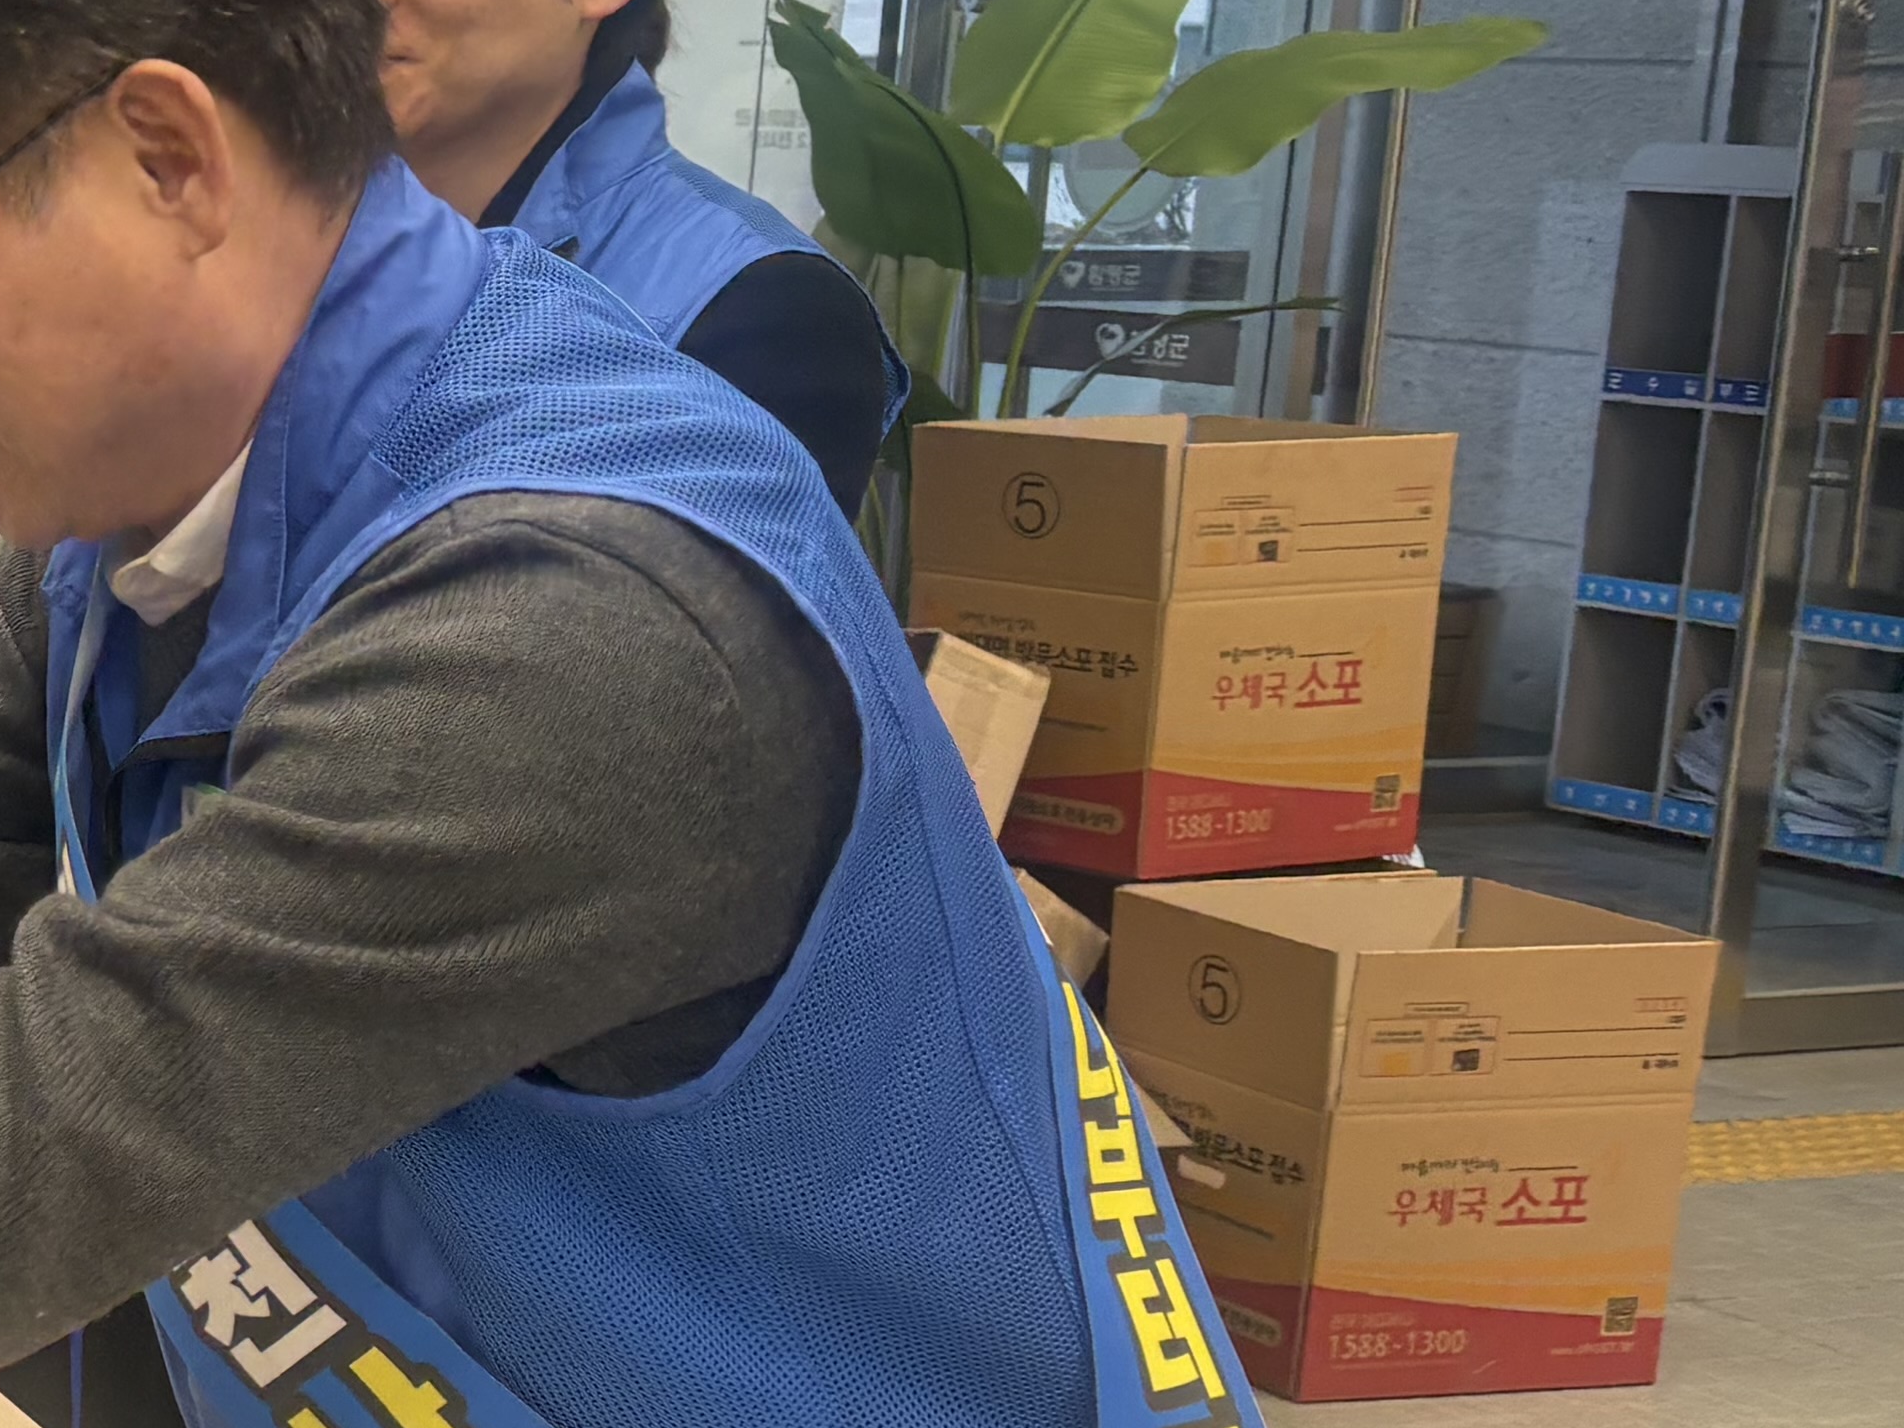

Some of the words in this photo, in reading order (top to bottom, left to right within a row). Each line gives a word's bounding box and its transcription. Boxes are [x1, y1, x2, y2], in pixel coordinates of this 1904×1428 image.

[1211, 675, 1288, 711] 우체국
[1294, 659, 1364, 709] 소포
[1166, 809, 1272, 841] 1588-1300
[1061, 981, 1224, 1401] 나부터
[1387, 1186, 1488, 1228] 우체국
[1495, 1174, 1590, 1227] 소포
[1327, 1328, 1468, 1360] 1588-1300
